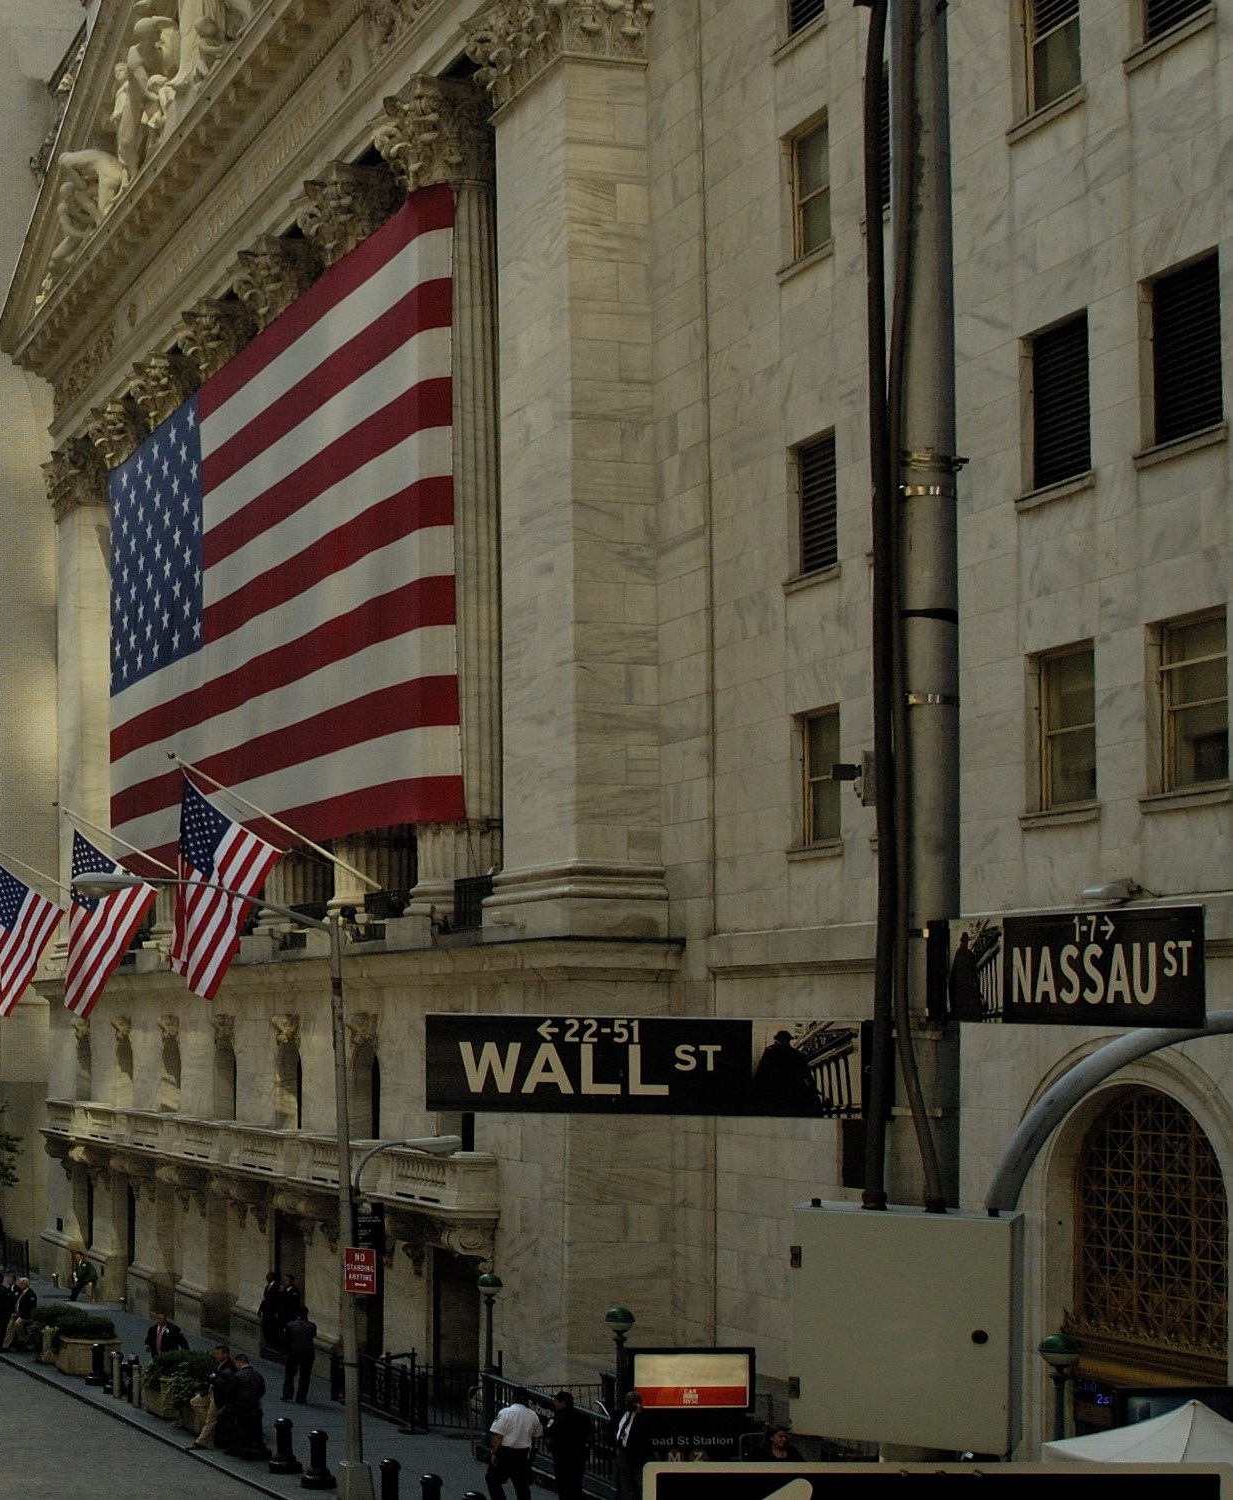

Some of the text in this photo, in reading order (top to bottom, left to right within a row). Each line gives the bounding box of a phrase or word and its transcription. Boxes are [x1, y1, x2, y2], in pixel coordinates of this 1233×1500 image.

[1073, 915, 1096, 942] 1-7
[1012, 940, 1192, 1005] NASSAU ST
[564, 1019, 640, 1043] 22-51
[459, 1041, 722, 1096] WALL ST
[354, 1253, 366, 1262] NO
[677, 1436, 690, 1446] St
[692, 1435, 734, 1446] Station
